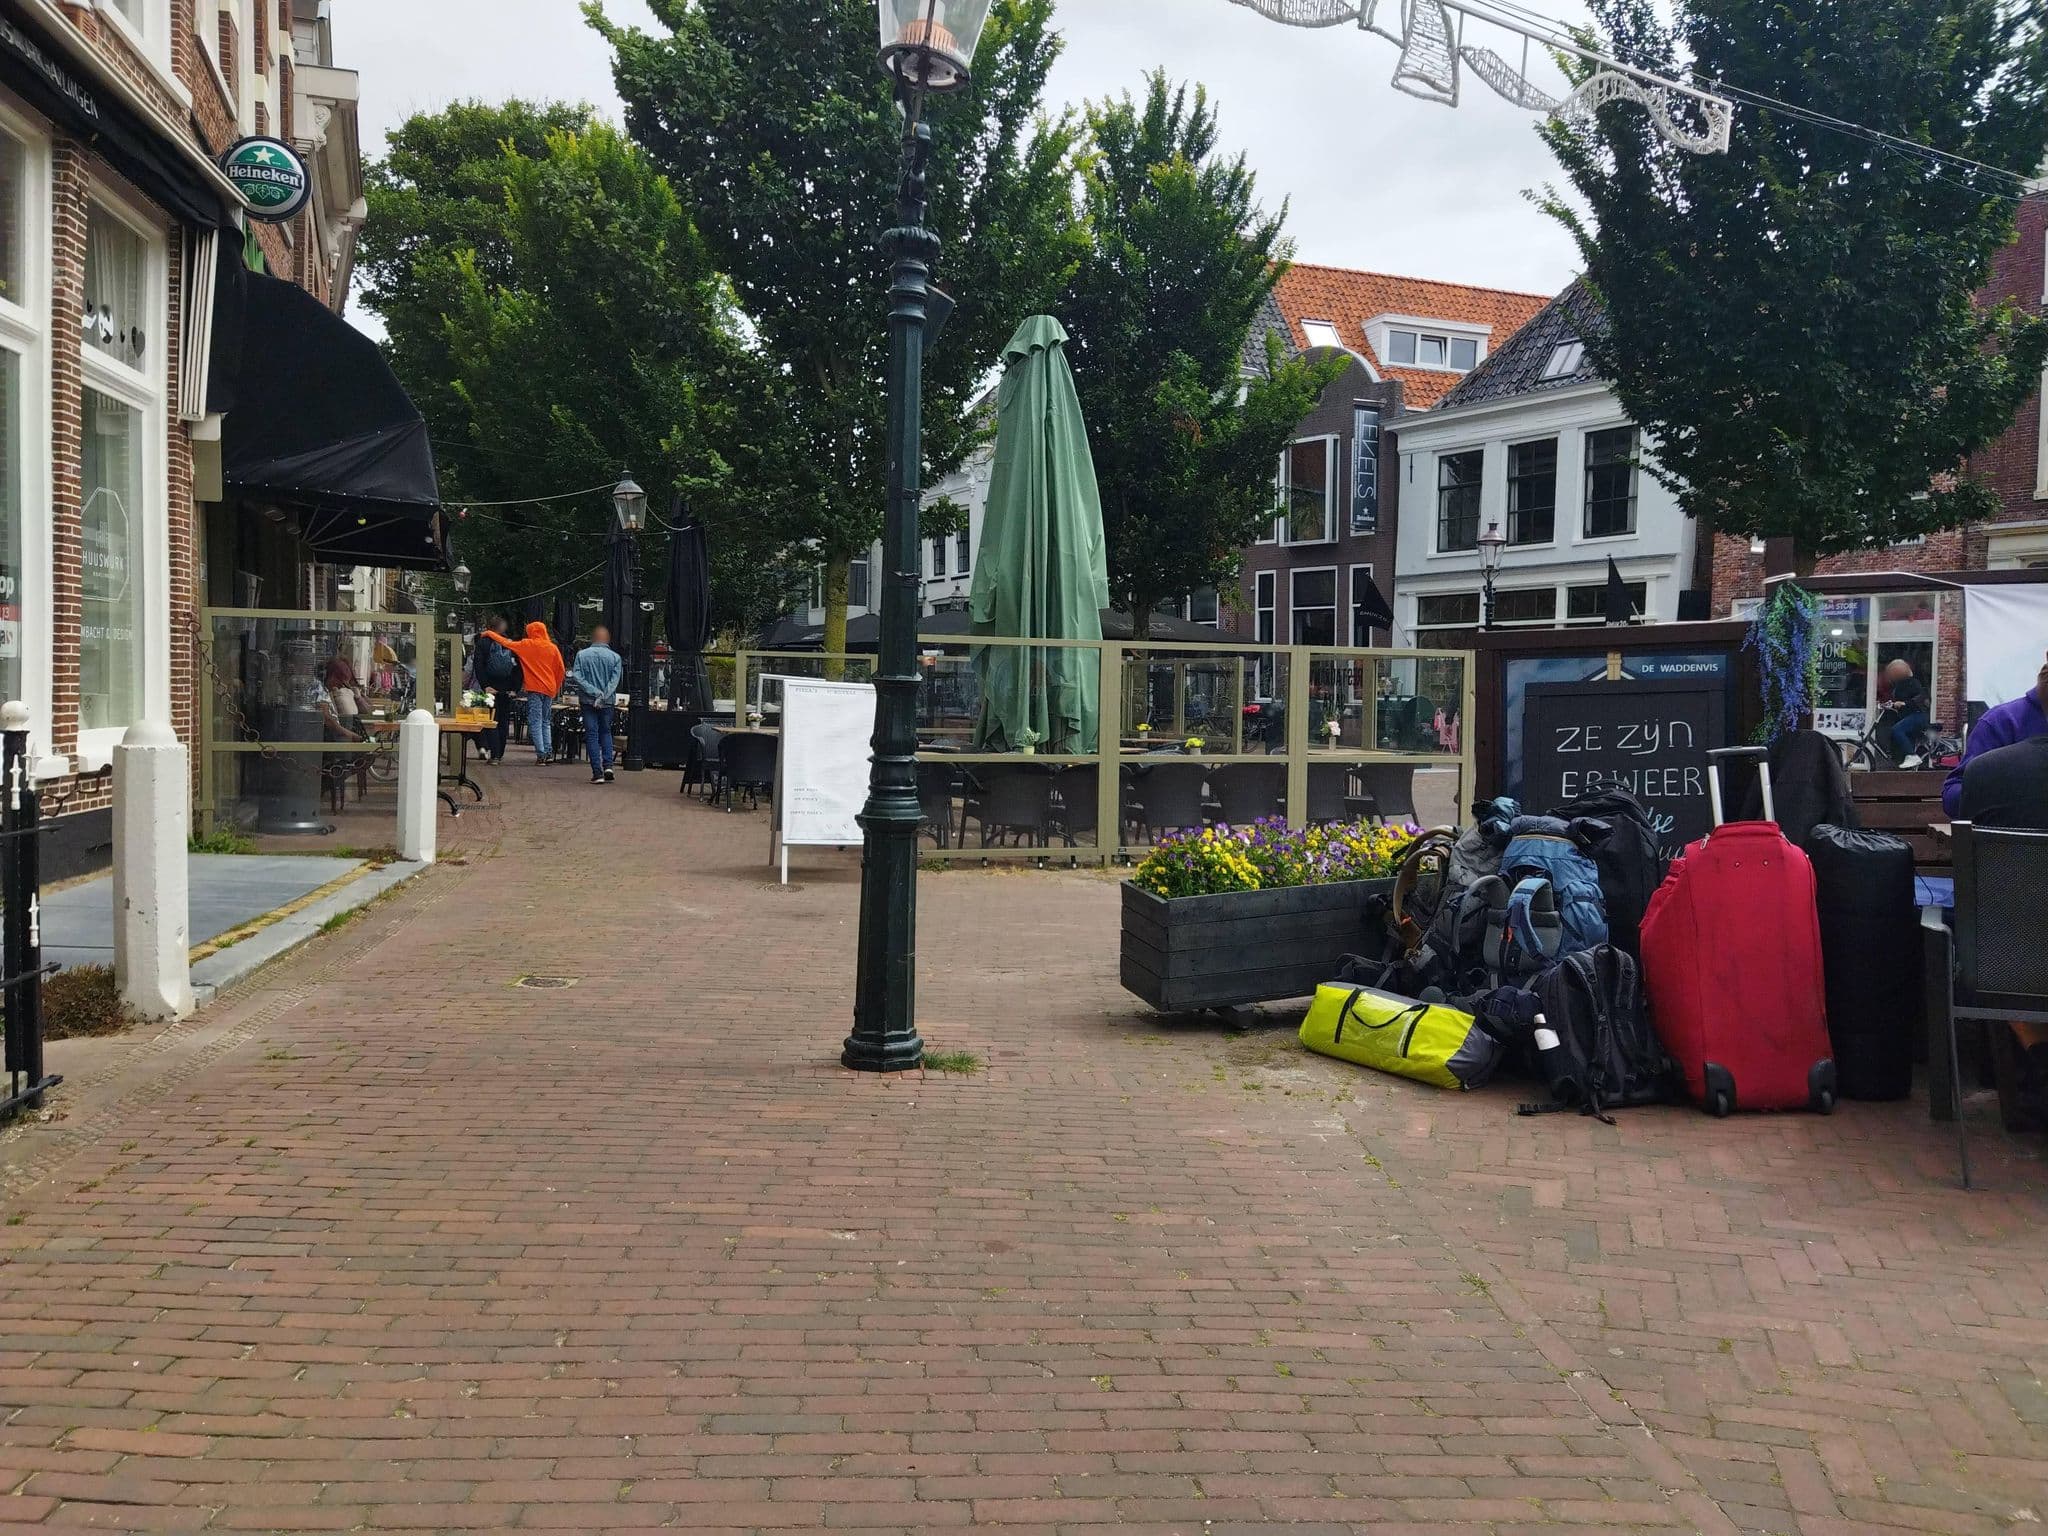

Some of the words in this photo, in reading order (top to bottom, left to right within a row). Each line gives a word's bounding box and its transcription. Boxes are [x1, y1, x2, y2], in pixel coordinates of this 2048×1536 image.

[228, 165, 299, 187] Heineken
[1357, 410, 1379, 499] LEVELS
[1835, 602, 1858, 610] STORE
[80, 625, 104, 640] MBACHT
[1819, 642, 1847, 658] TORE
[1641, 664, 1655, 673] DE
[1660, 663, 1719, 673] WADDENVIS
[1818, 659, 1847, 673] arlingen
[1556, 725, 1602, 753] ZE
[1611, 766, 1705, 798] WEER
